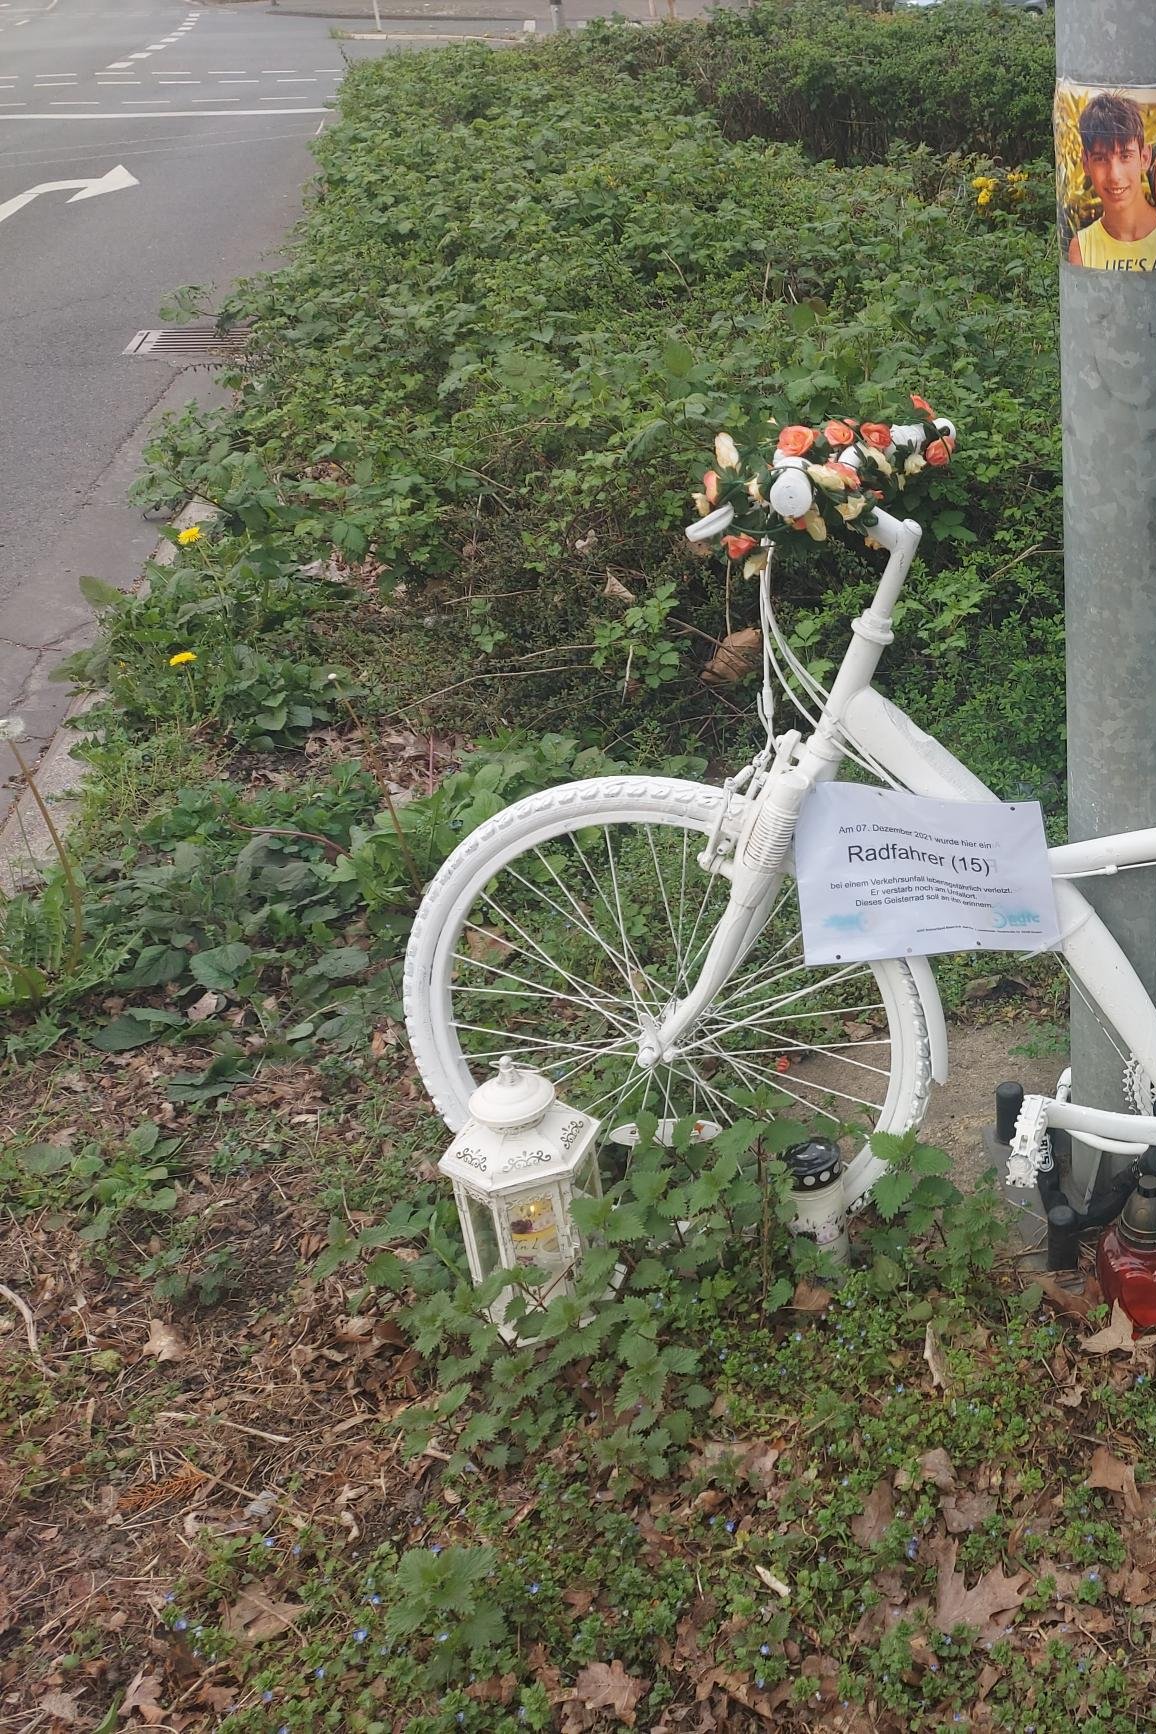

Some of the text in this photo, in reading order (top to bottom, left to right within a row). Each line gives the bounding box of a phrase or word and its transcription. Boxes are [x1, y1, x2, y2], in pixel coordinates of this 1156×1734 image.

[839, 824, 991, 849] Am 07. Dezember 2021 wurde hier ein
[848, 844, 990, 877] Radfahrer (15)
[845, 880, 869, 888] einem
[871, 875, 925, 885] Verkehrsunfall
[983, 886, 1012, 894] verletzt.
[882, 886, 912, 894] verstarb
[915, 884, 933, 892] noch
[884, 895, 924, 904] Geisterrad
